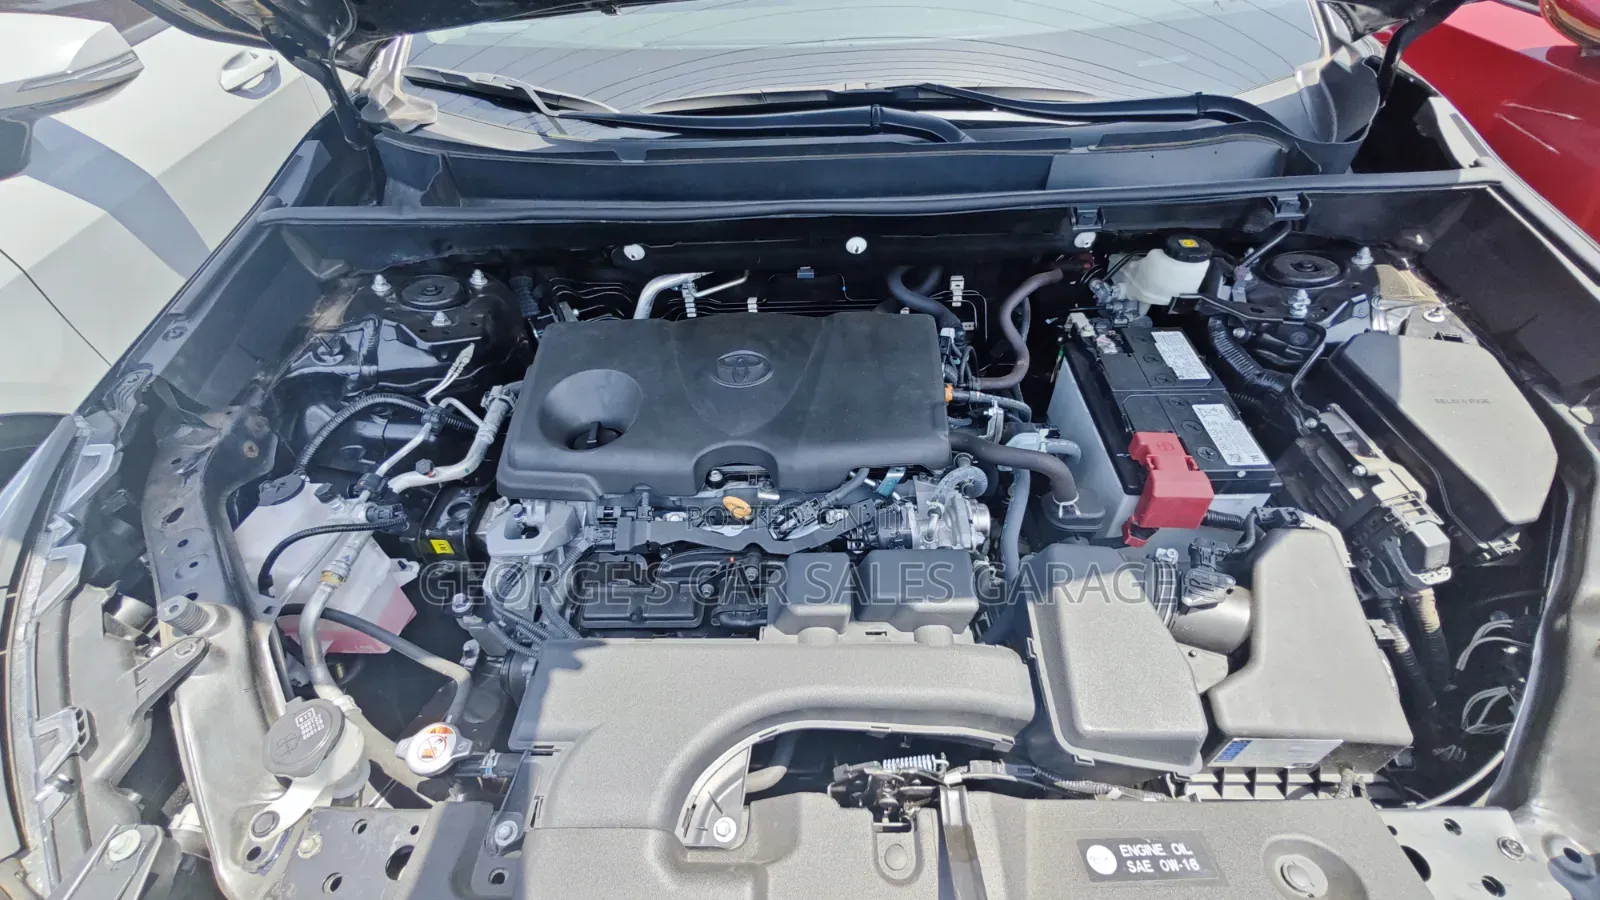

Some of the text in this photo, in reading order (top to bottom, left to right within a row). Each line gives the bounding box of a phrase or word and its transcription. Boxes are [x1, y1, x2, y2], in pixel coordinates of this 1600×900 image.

[1119, 843, 1193, 857] ENGINE OIL
[1126, 860, 1154, 873] SAE
